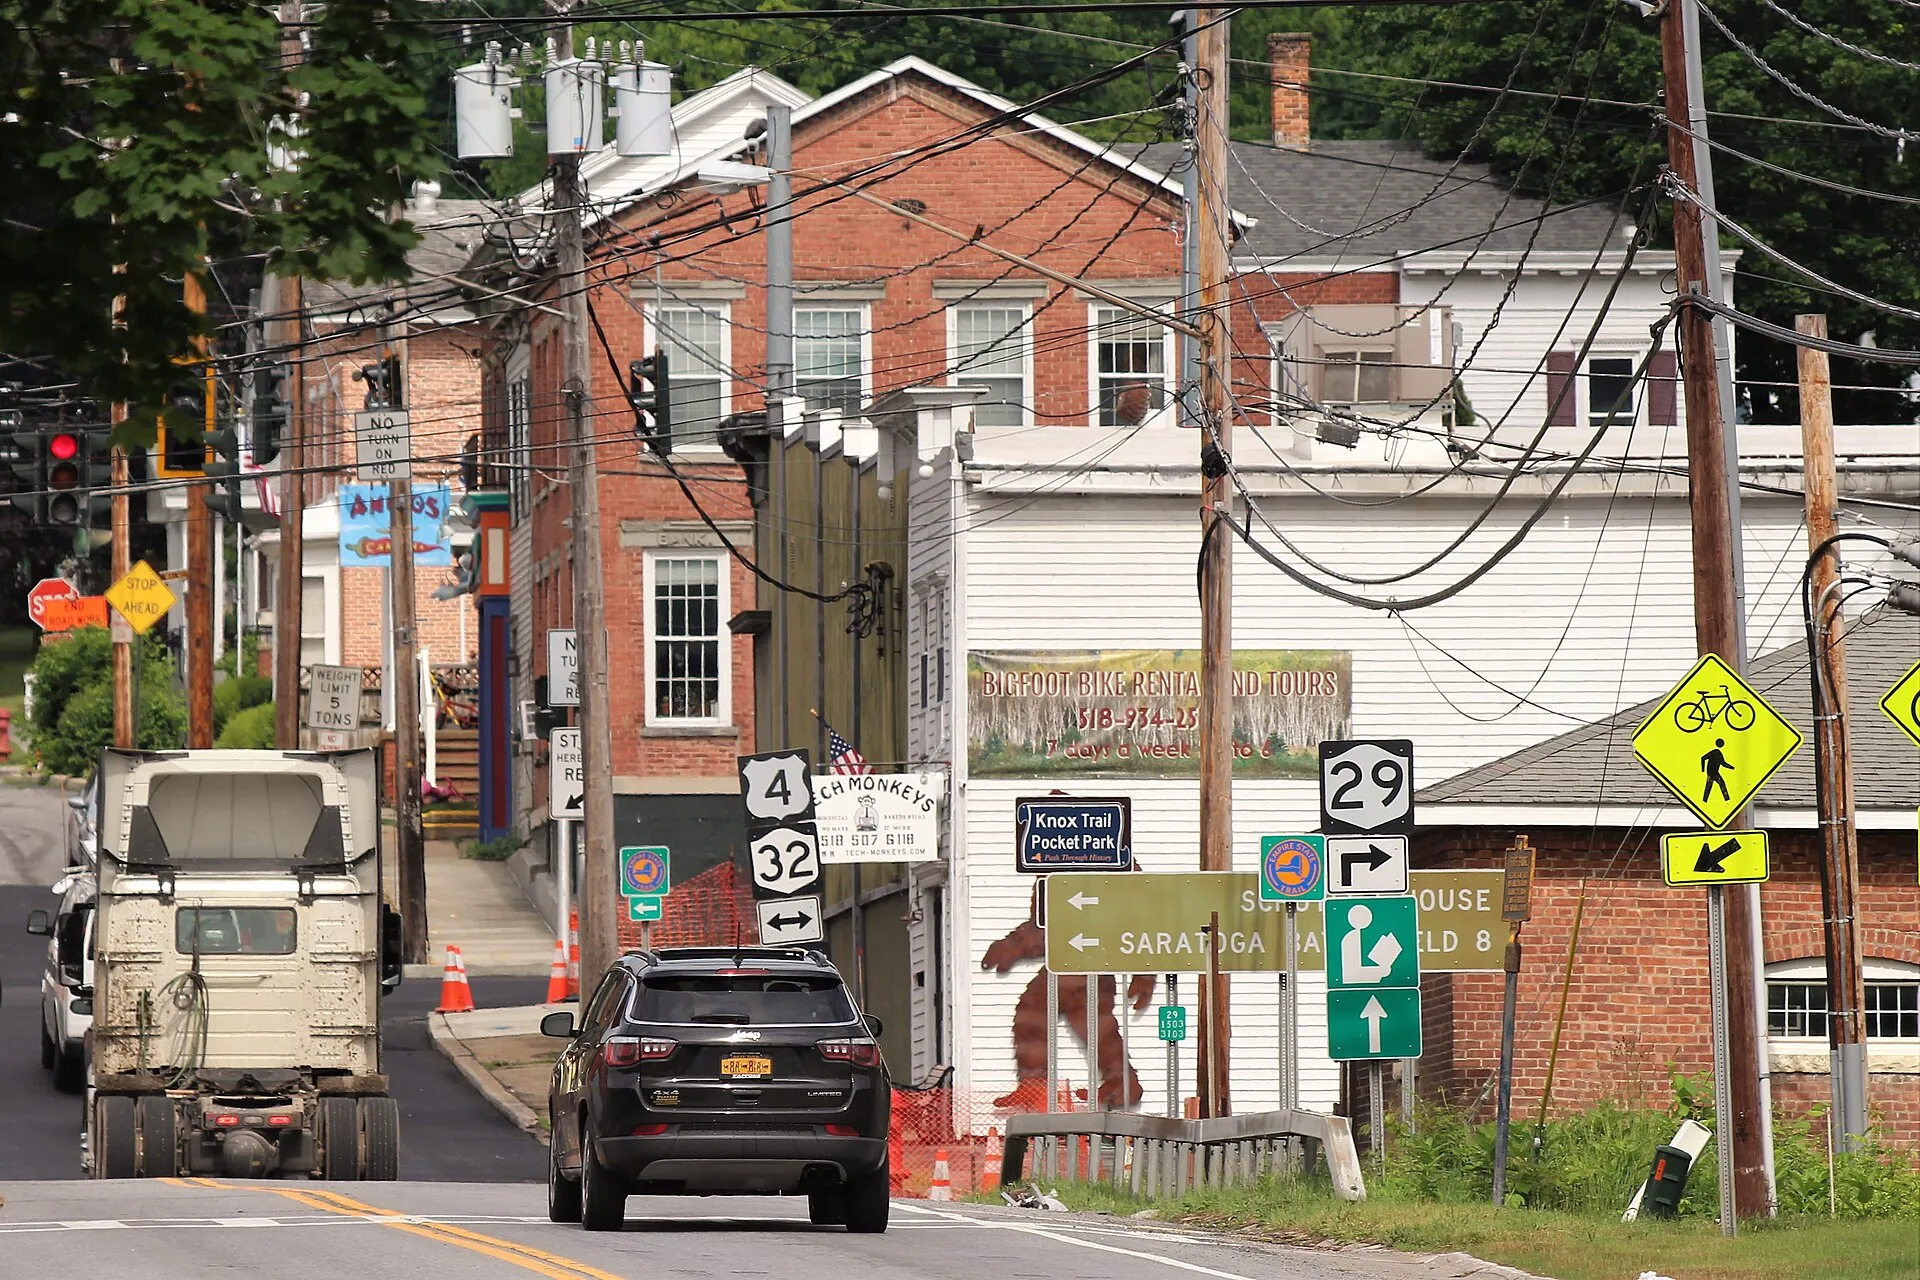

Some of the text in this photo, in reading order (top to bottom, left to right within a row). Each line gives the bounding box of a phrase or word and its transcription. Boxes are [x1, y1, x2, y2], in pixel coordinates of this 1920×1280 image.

[371, 417, 393, 429] NO
[368, 434, 399, 445] TURN
[375, 448, 392, 459] ON
[372, 464, 395, 474] RED
[127, 577, 157, 591] STOP
[64, 601, 84, 612] END
[123, 601, 159, 615] AHEAD
[49, 616, 74, 626] ROAD
[565, 637, 577, 651] N
[561, 655, 577, 667] TU
[317, 669, 358, 682] WEIGHT
[320, 683, 350, 694] LIMIT
[983, 670, 1338, 698] BIGFOOT BIKE RENTA ND TOURS
[566, 690, 580, 699] RE
[330, 696, 340, 708] 5
[315, 711, 351, 726] TONS
[1078, 706, 1200, 731] 518-934-25
[559, 734, 579, 748] ST
[1046, 739, 1058, 759] 7
[1063, 740, 1111, 763] days
[1116, 744, 1130, 759] a
[1136, 741, 1192, 759] week
[1260, 738, 1273, 759] 6
[565, 768, 584, 781] RE
[764, 769, 791, 806] 4
[1331, 759, 1403, 810] 29
[849, 776, 935, 812] MONKEYS
[1035, 813, 1112, 828] Knox Trail
[821, 833, 914, 847] 518 507 6118
[1031, 835, 1115, 850] Pocket Park
[1089, 854, 1112, 862] History
[1269, 842, 1317, 863] EMPIRE STATE
[758, 840, 814, 883] 32
[1281, 885, 1307, 894] TRAIL
[1412, 888, 1491, 912] OUSE
[1119, 931, 1266, 954] SARATOGA
[1475, 929, 1492, 952] 8
[1166, 1010, 1178, 1019] 29
[1161, 1020, 1184, 1029] 1503
[733, 1029, 762, 1042] Jeep
[1160, 1030, 1184, 1038] 3103
